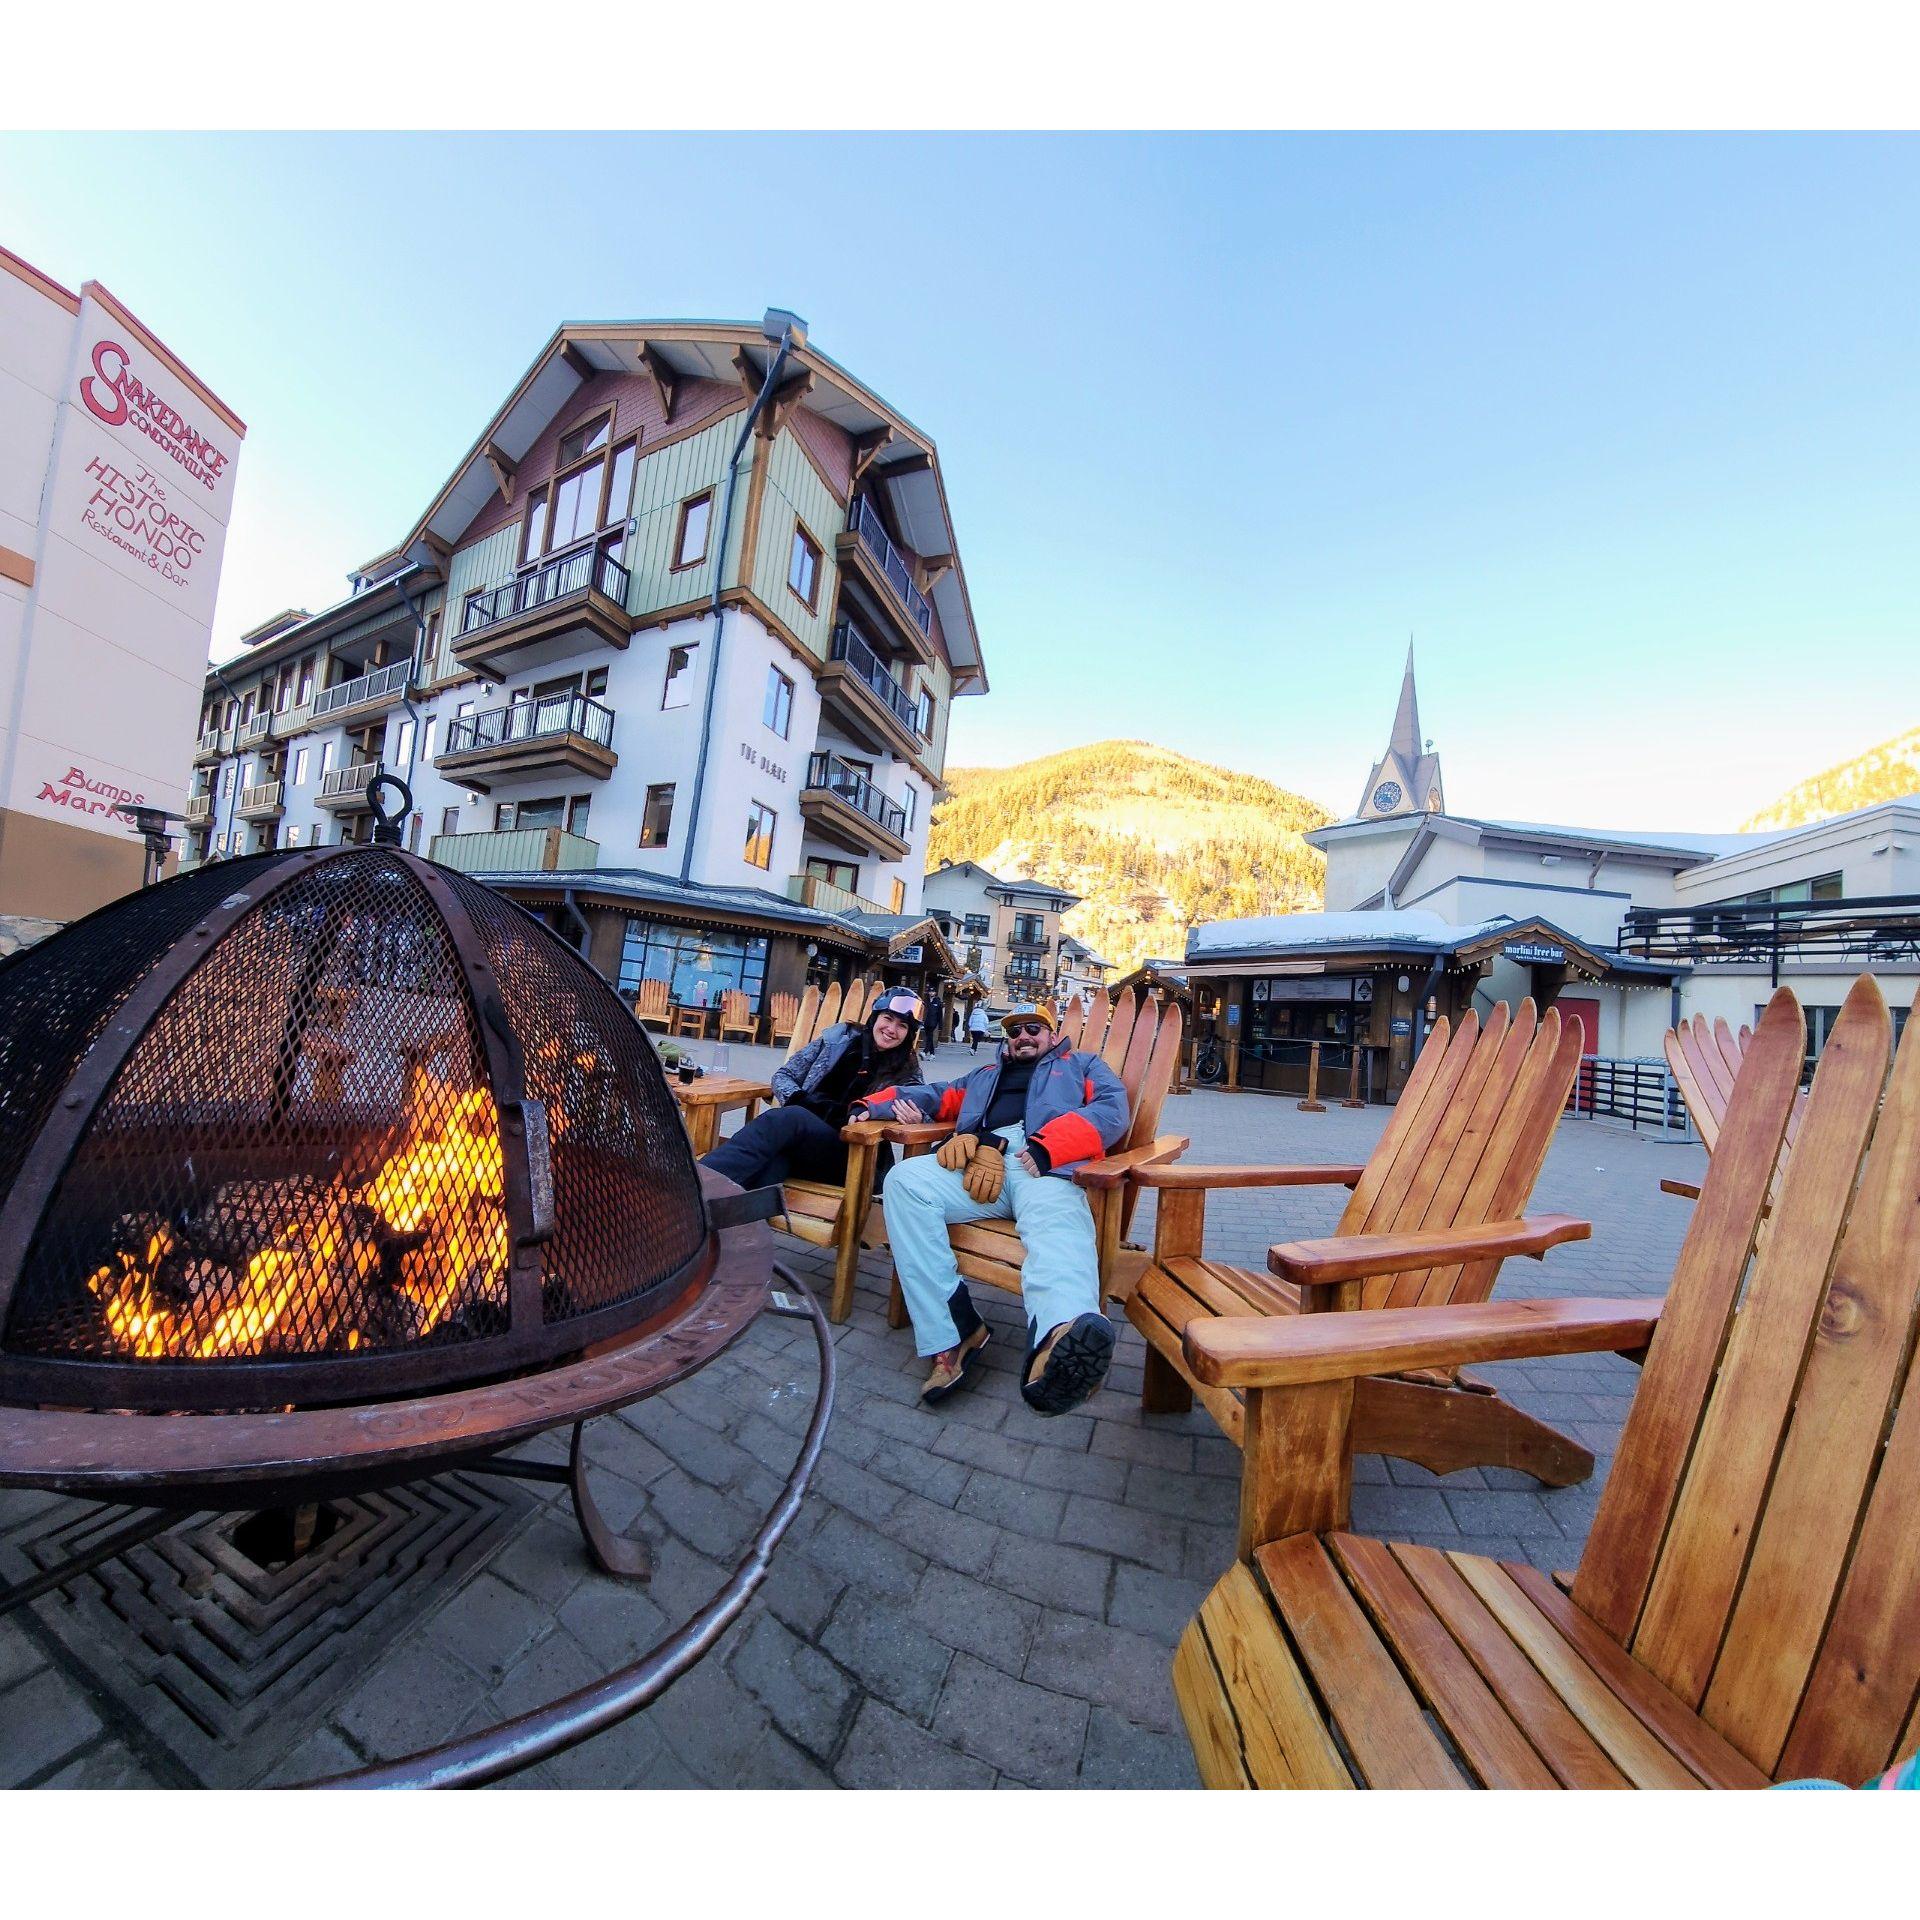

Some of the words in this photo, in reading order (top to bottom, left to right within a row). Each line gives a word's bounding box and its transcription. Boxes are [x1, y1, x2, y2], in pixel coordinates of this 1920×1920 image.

[80, 340, 229, 478] SNAKEDANCE
[128, 409, 215, 491] CONDOMINIUMS
[135, 463, 167, 501] The
[84, 455, 205, 554] HISTORIC
[88, 487, 192, 570] HONDO
[81, 508, 148, 563] Restaurant
[148, 553, 160, 572] &
[161, 561, 189, 587] Bar
[35, 781, 136, 825] Marke
[58, 766, 145, 805] Bumps
[1505, 945, 1533, 955] martini
[1534, 946, 1550, 956] tree
[1550, 947, 1564, 958] bar
